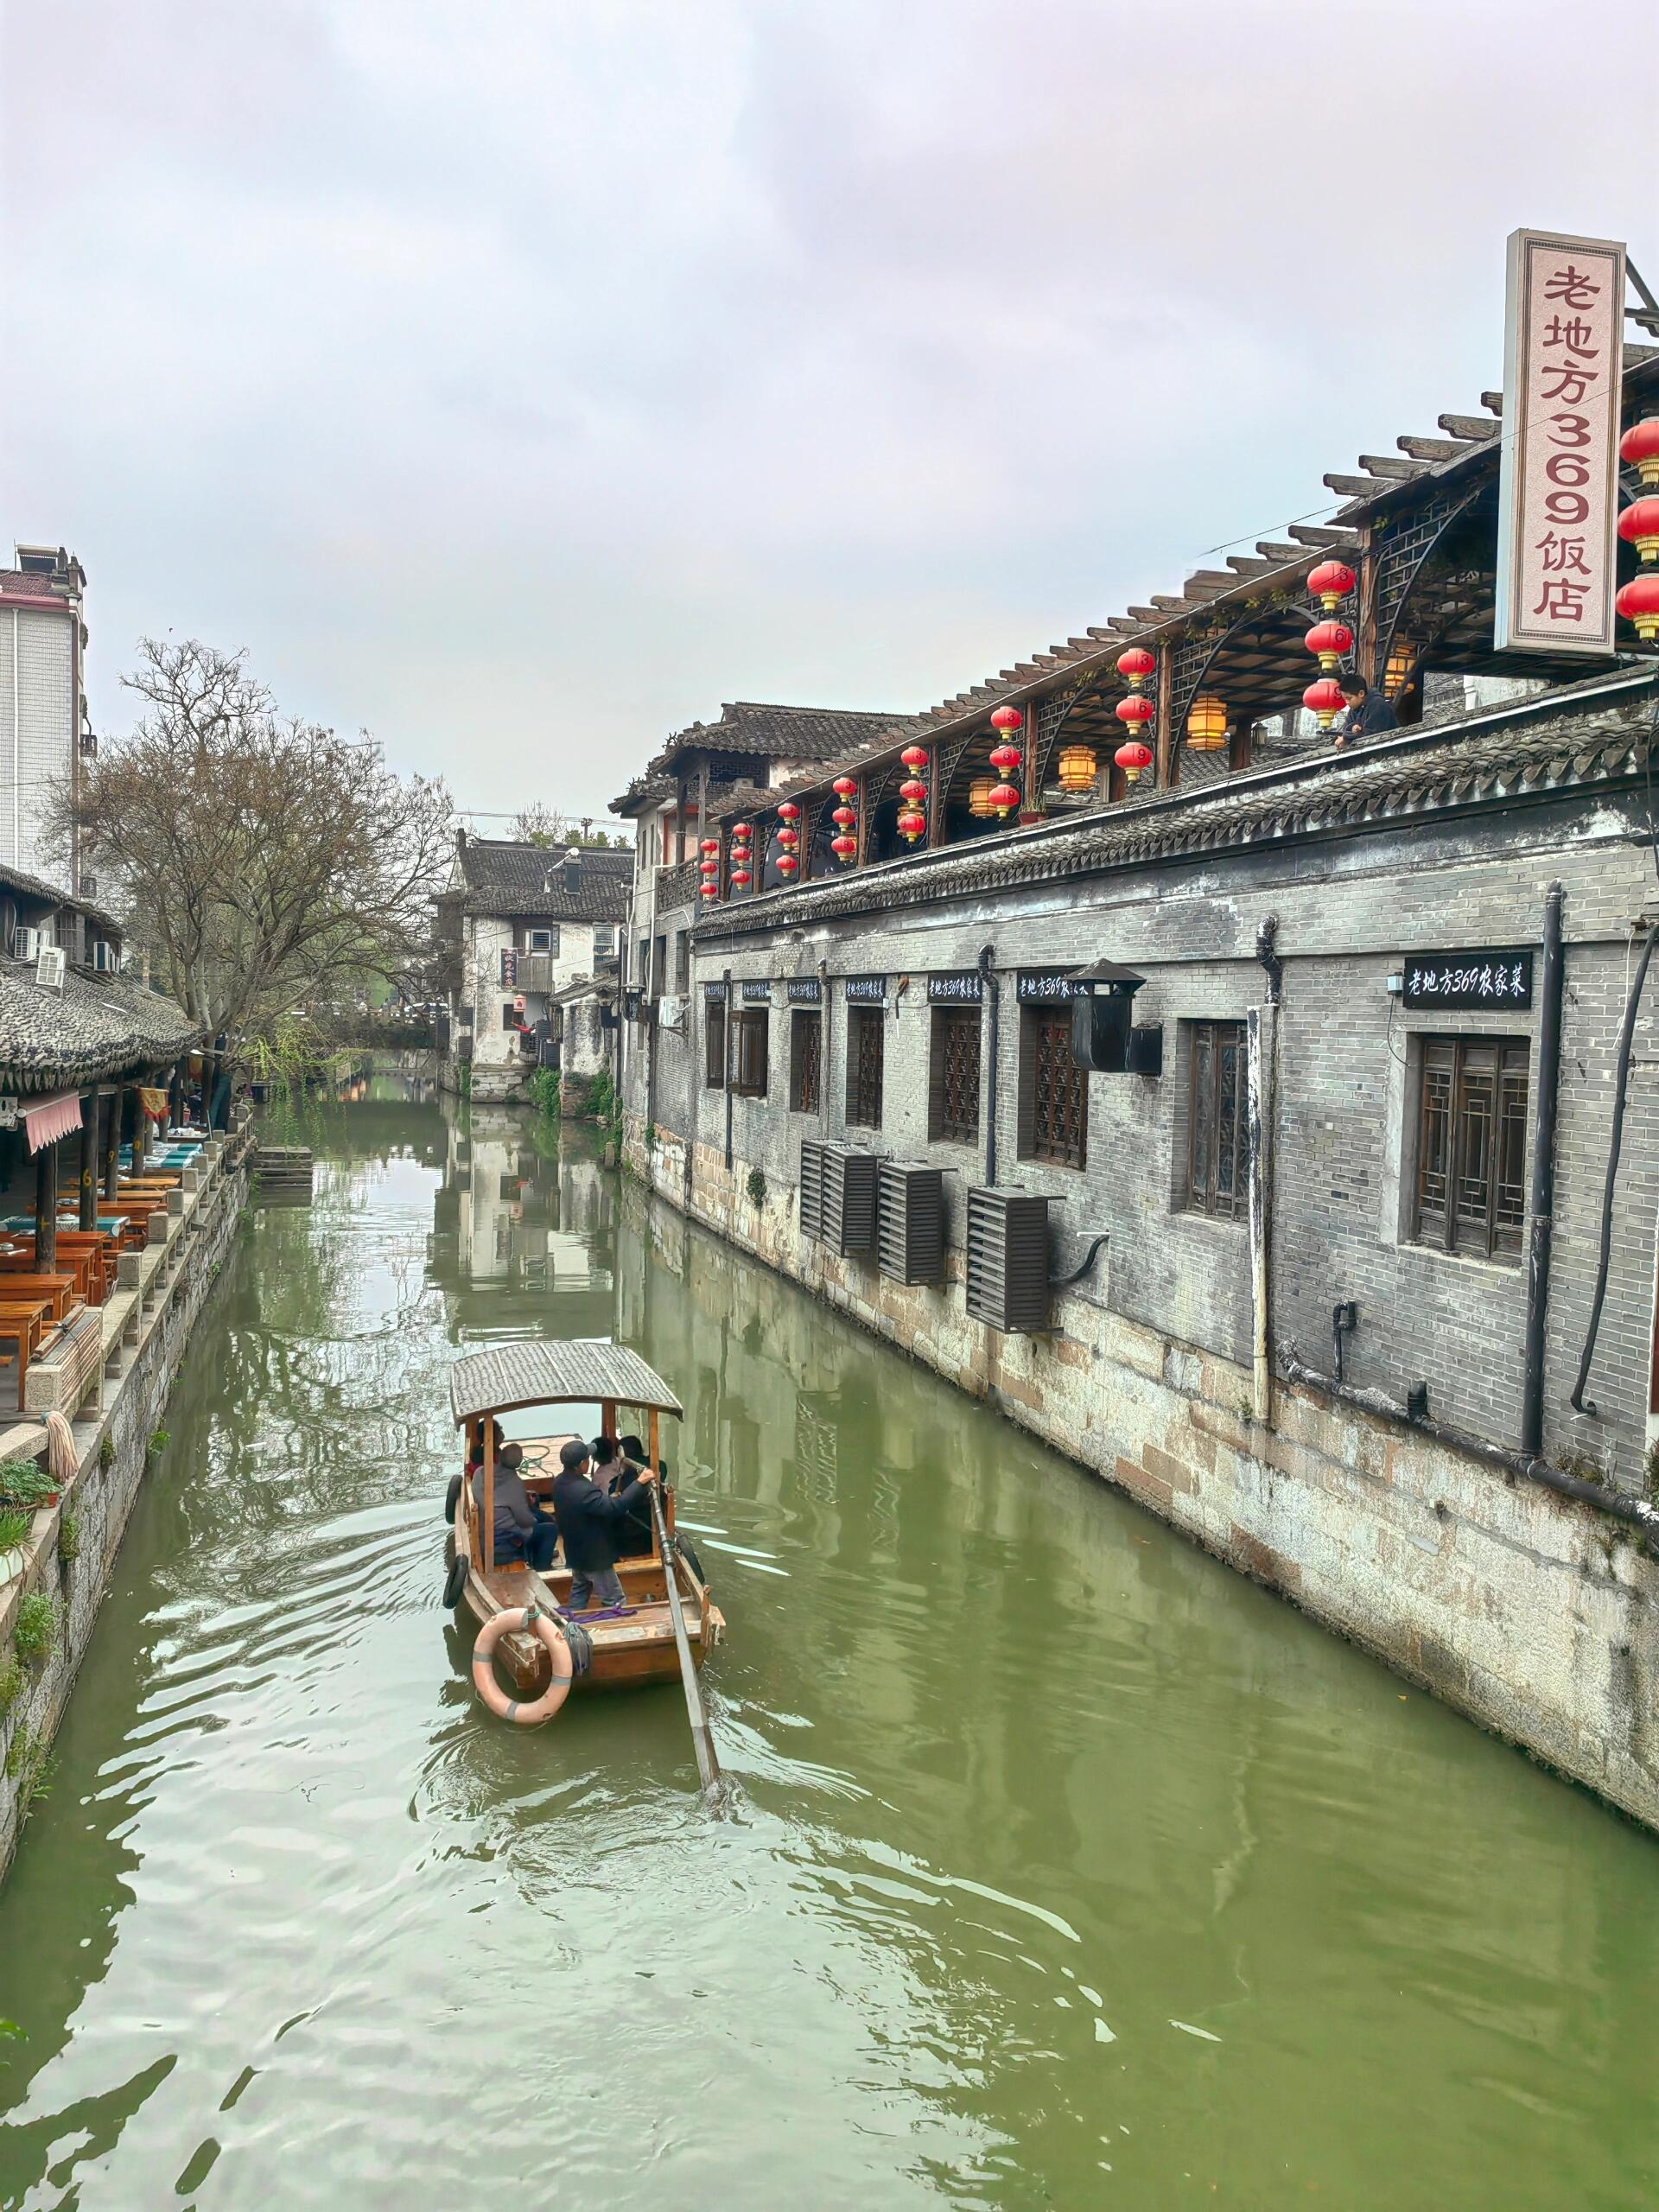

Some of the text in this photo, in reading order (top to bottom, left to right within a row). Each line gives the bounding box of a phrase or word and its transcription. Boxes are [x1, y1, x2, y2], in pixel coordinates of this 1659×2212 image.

[1533, 265, 1600, 622] 老地方369饭店
[1339, 567, 1348, 582] 3
[1334, 628, 1344, 643] 6
[1137, 654, 1149, 760] 3 6 9
[1007, 712, 1015, 722] 3
[916, 751, 922, 760] 3
[1007, 790, 1015, 800] 9
[928, 976, 980, 999] 老地方369农家菜
[1408, 963, 1526, 997] 老地方369农家菜
